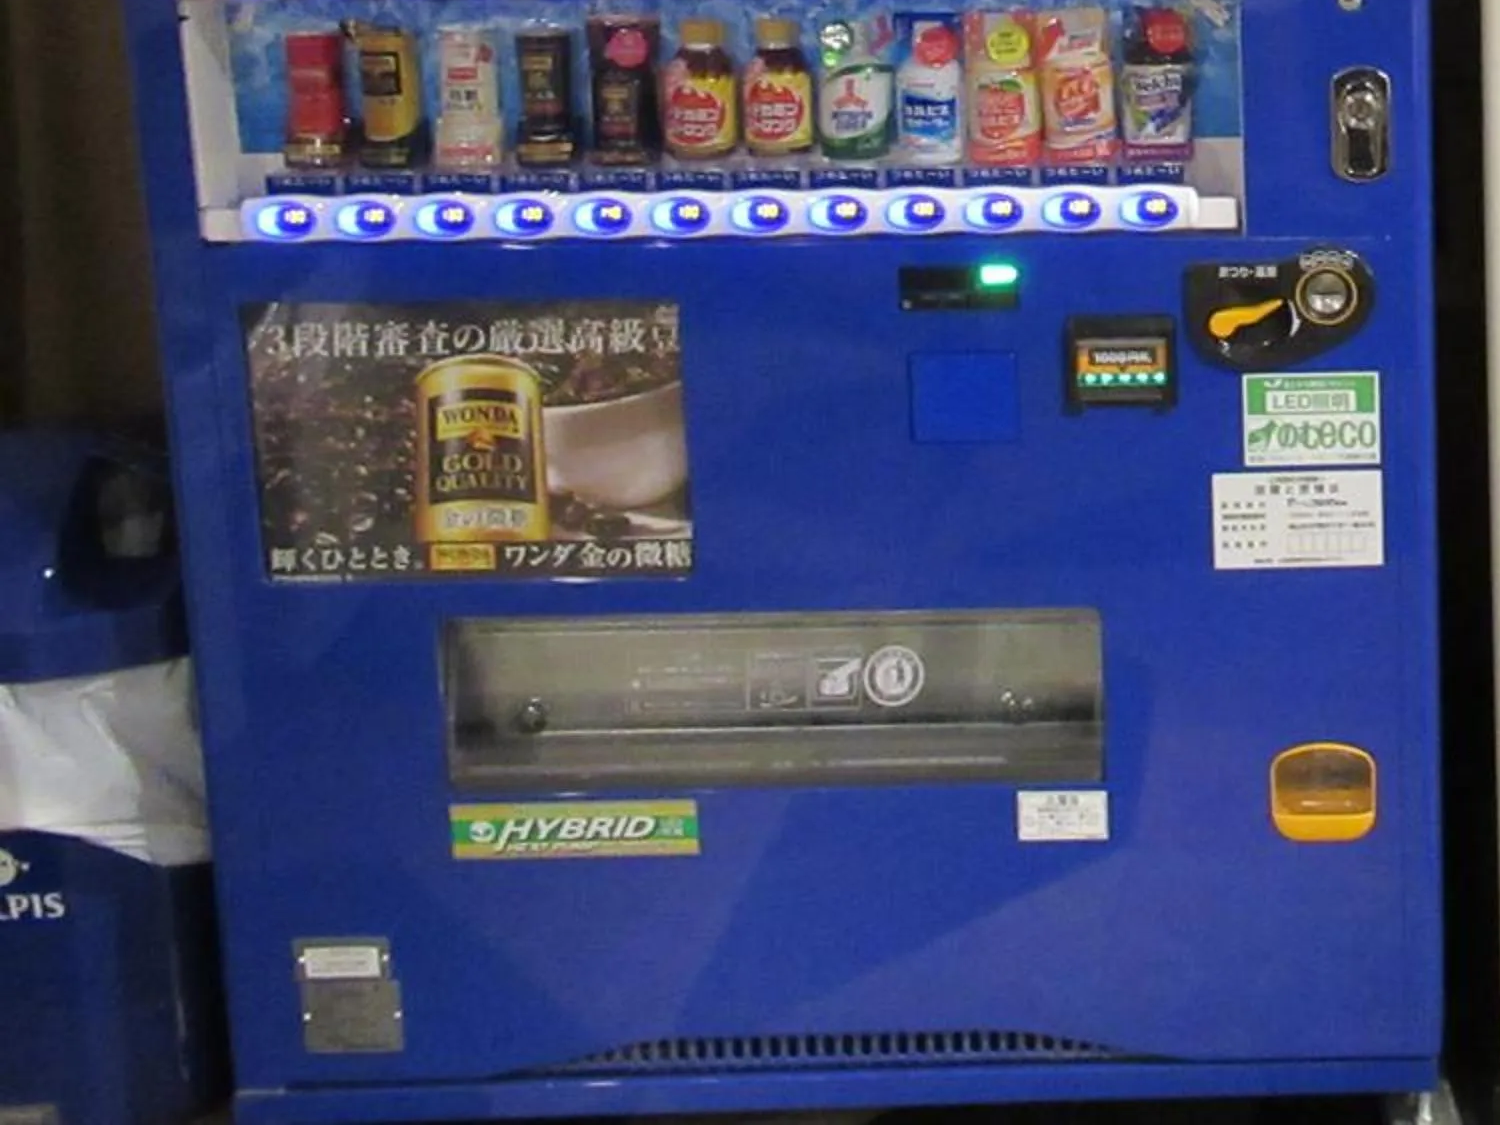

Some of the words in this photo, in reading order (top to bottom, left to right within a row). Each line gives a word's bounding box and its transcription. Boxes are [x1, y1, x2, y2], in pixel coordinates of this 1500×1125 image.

[441, 405, 519, 427] WONDA
[442, 456, 523, 474] GOLD
[435, 475, 529, 492] QUALITY
[269, 545, 426, 572] 輝くひととき。
[504, 544, 578, 566] ワンダ
[581, 542, 692, 570] 金の微糖
[498, 815, 656, 852] HYBRID
